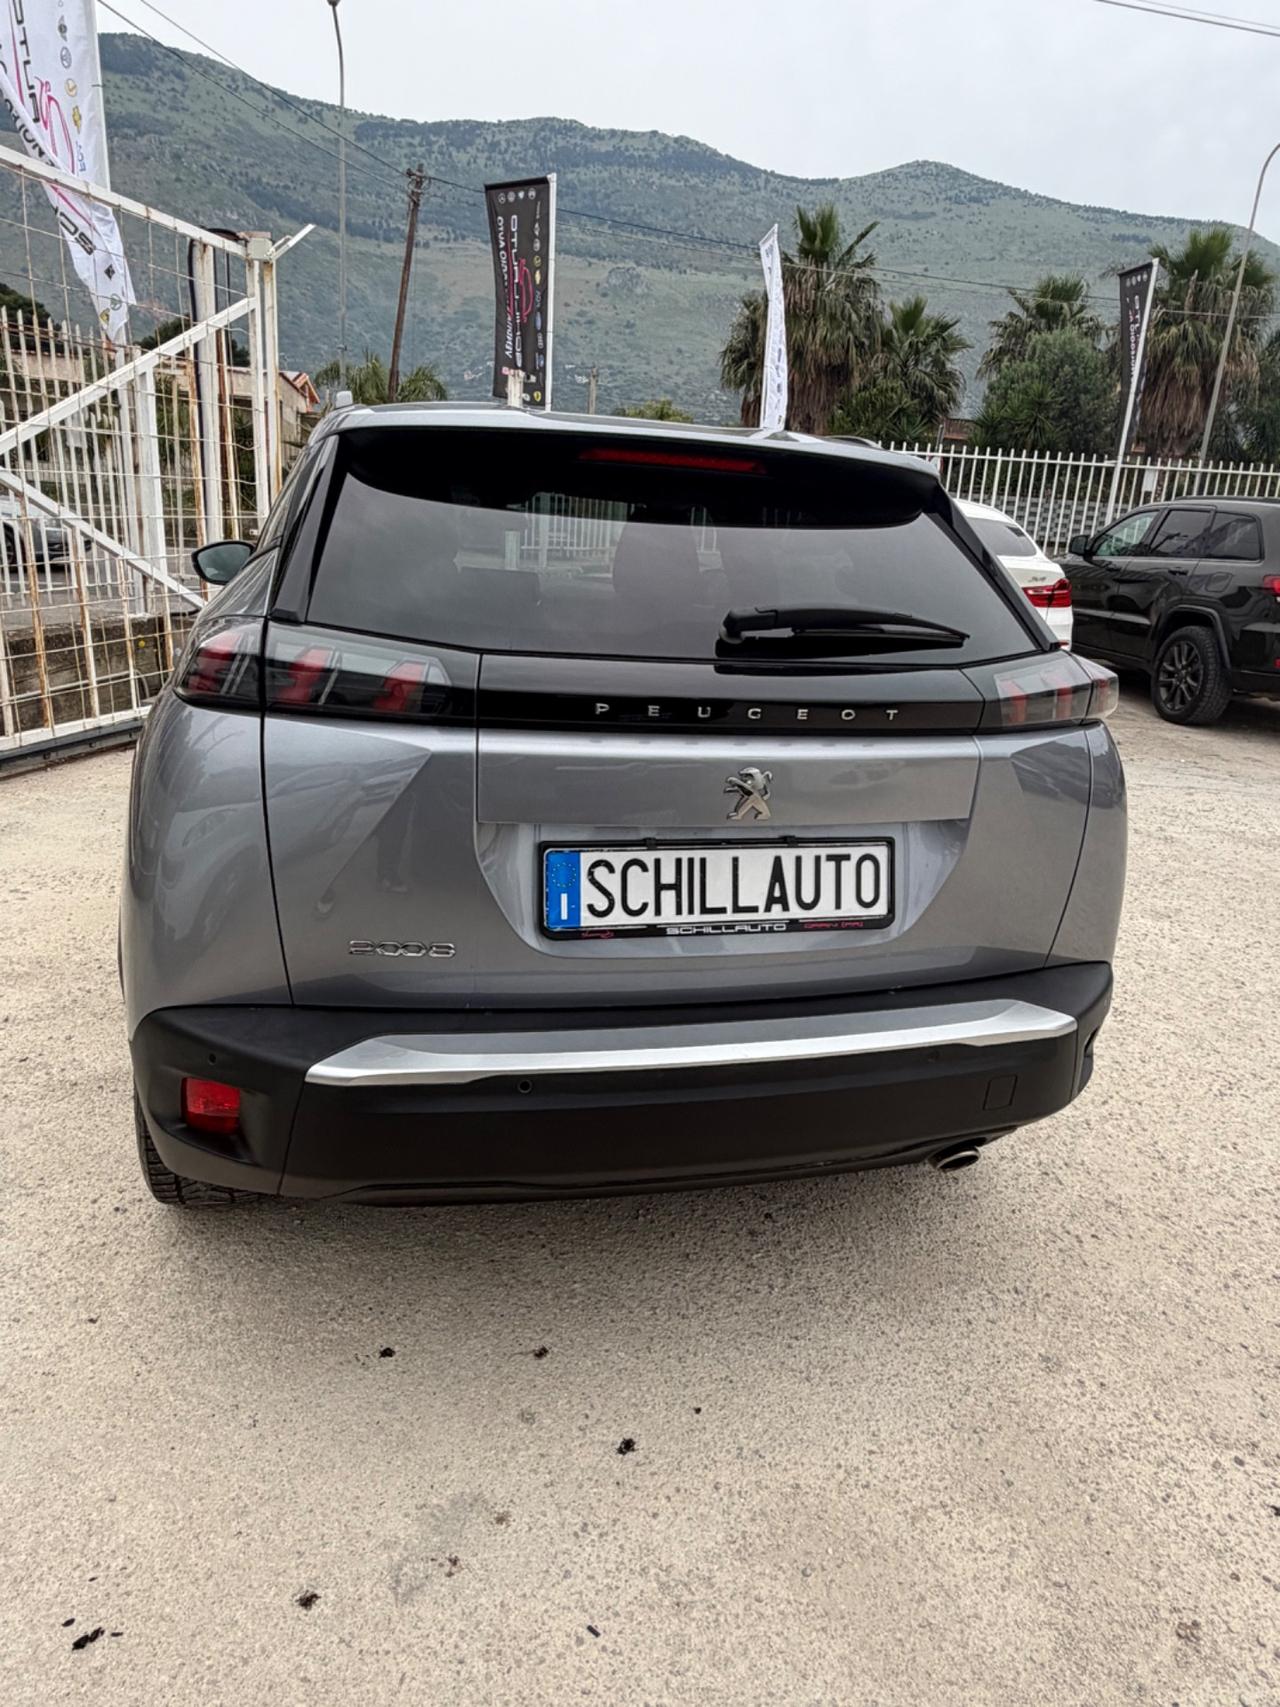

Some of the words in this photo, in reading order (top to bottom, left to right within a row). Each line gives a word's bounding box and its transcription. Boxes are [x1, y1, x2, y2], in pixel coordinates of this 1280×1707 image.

[595, 702, 899, 721] PEUGEOT
[586, 853, 881, 918] SCHILLAUTO
[561, 893, 567, 920] I
[666, 922, 786, 935] SCHILLAUTO
[348, 940, 456, 957] 2008
